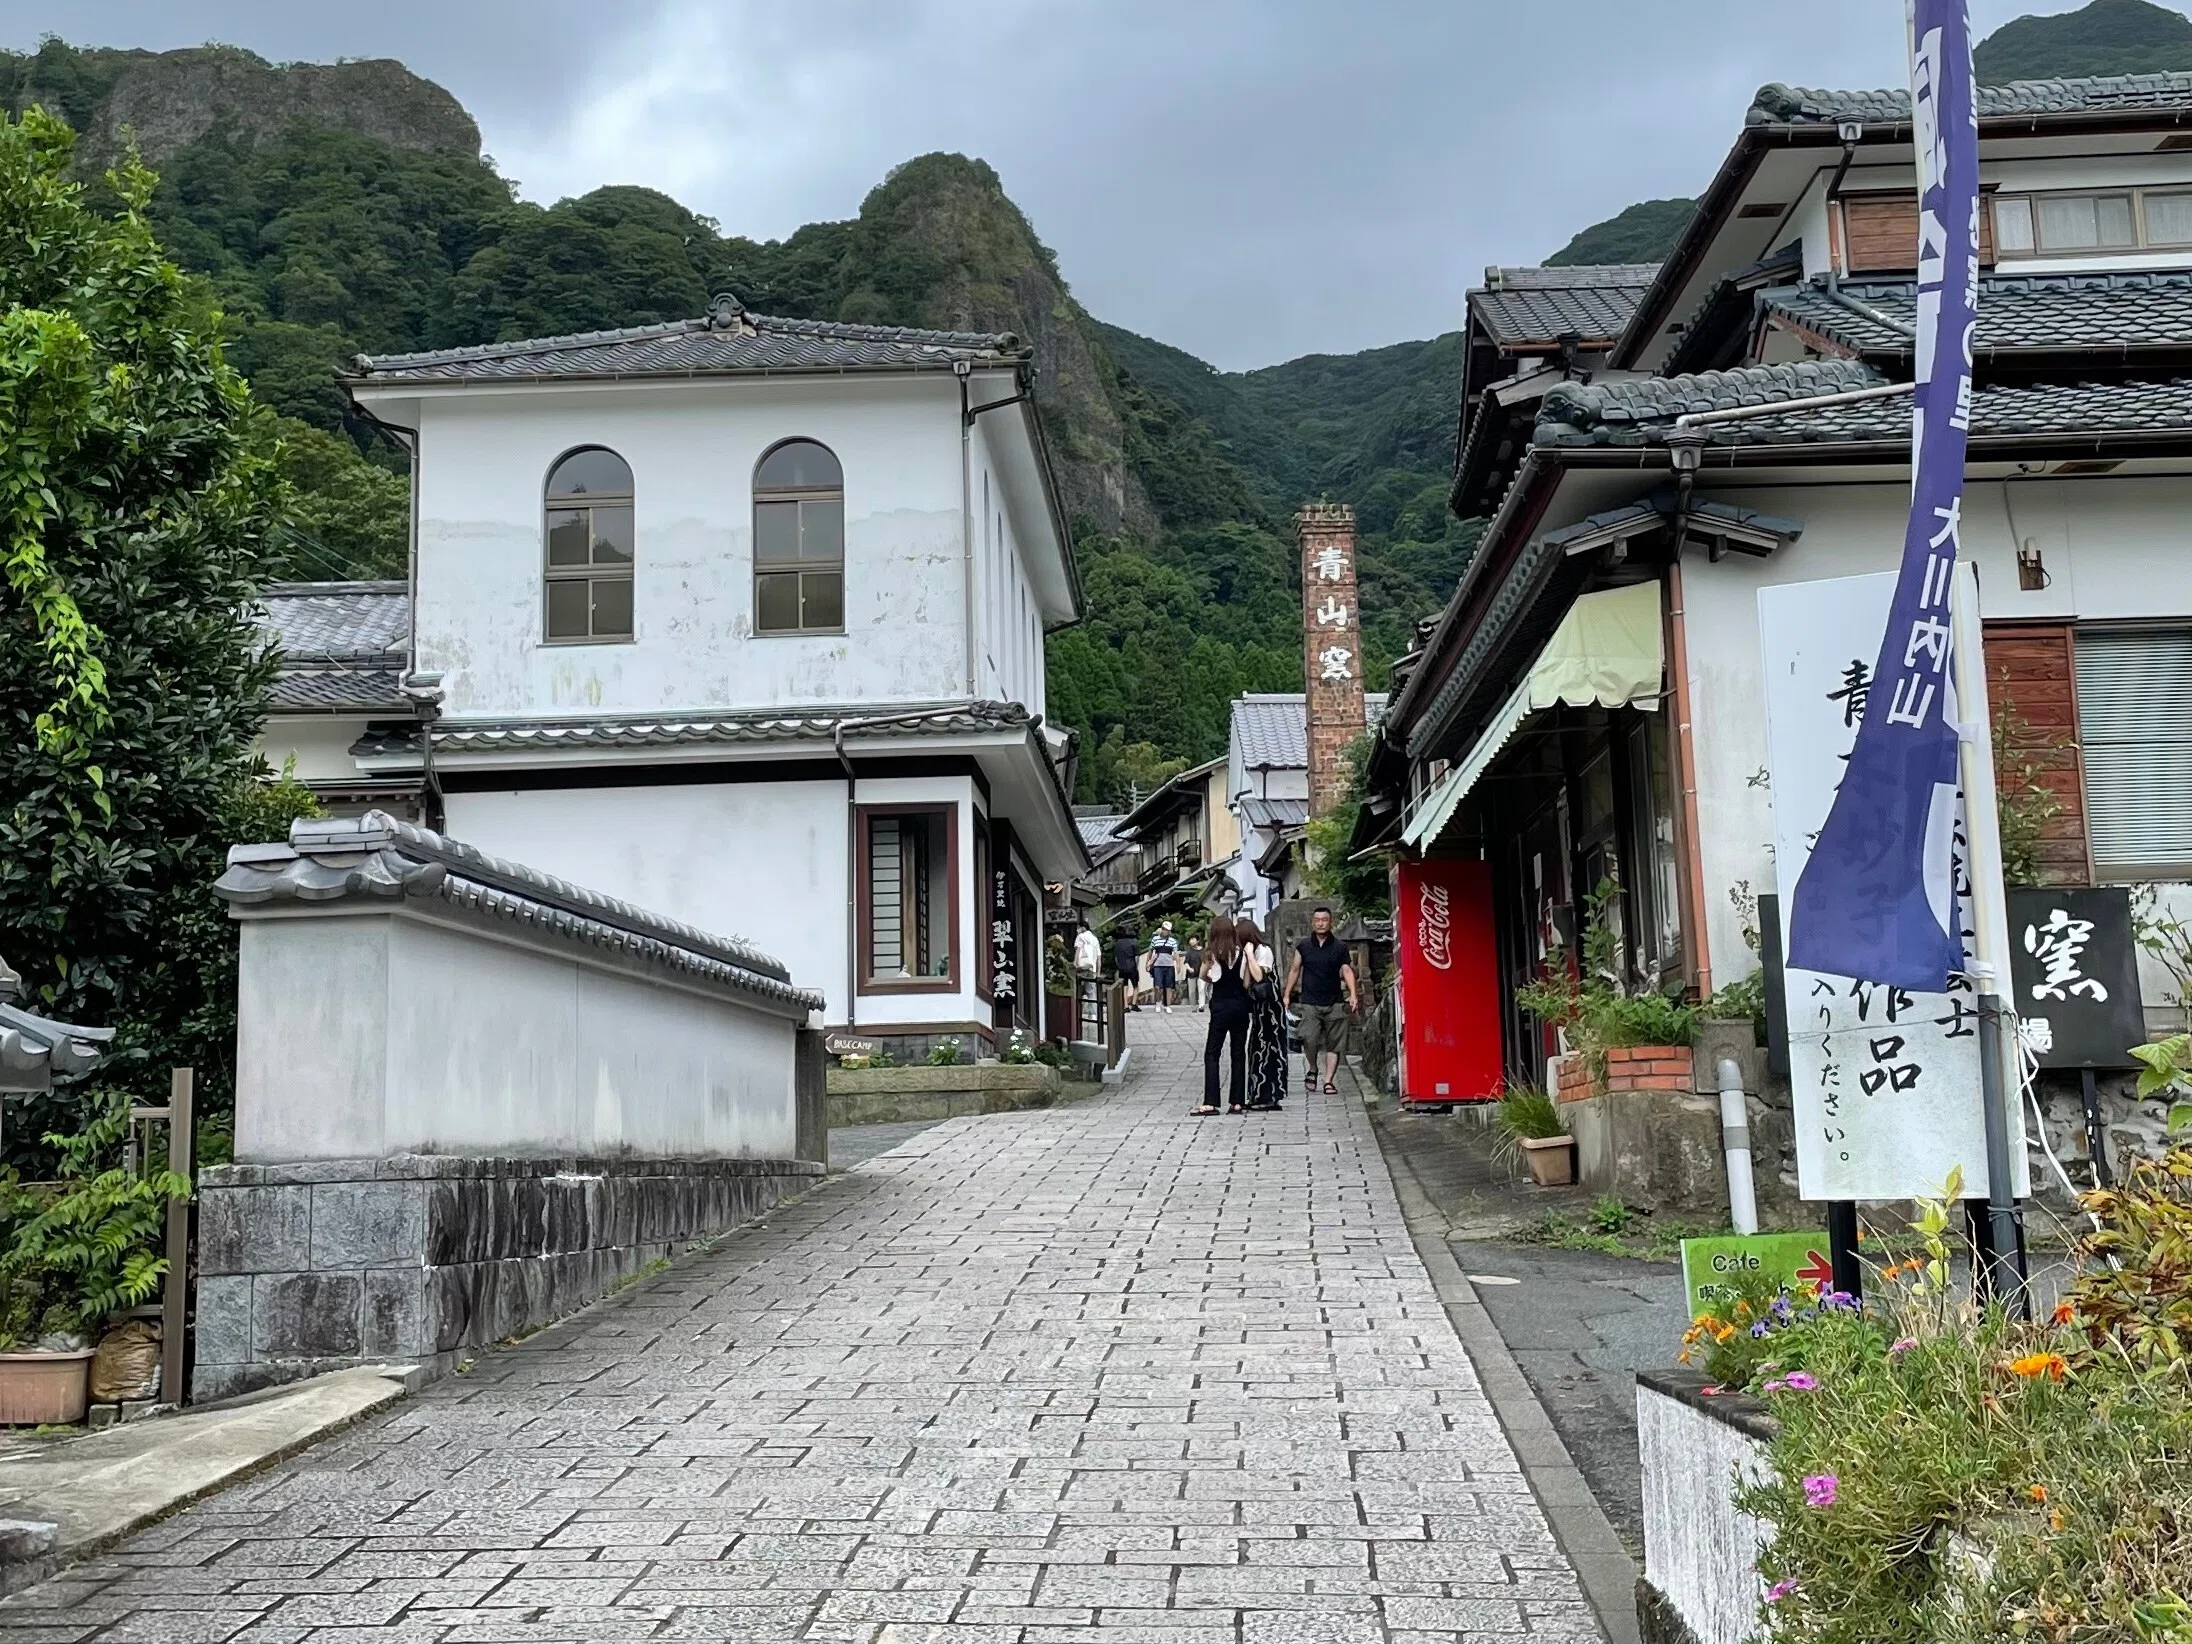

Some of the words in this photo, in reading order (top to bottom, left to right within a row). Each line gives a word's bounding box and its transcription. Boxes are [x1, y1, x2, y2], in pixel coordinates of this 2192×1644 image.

[1312, 546, 1353, 681] 青山窯
[1420, 881, 1452, 970] Coca-Cola
